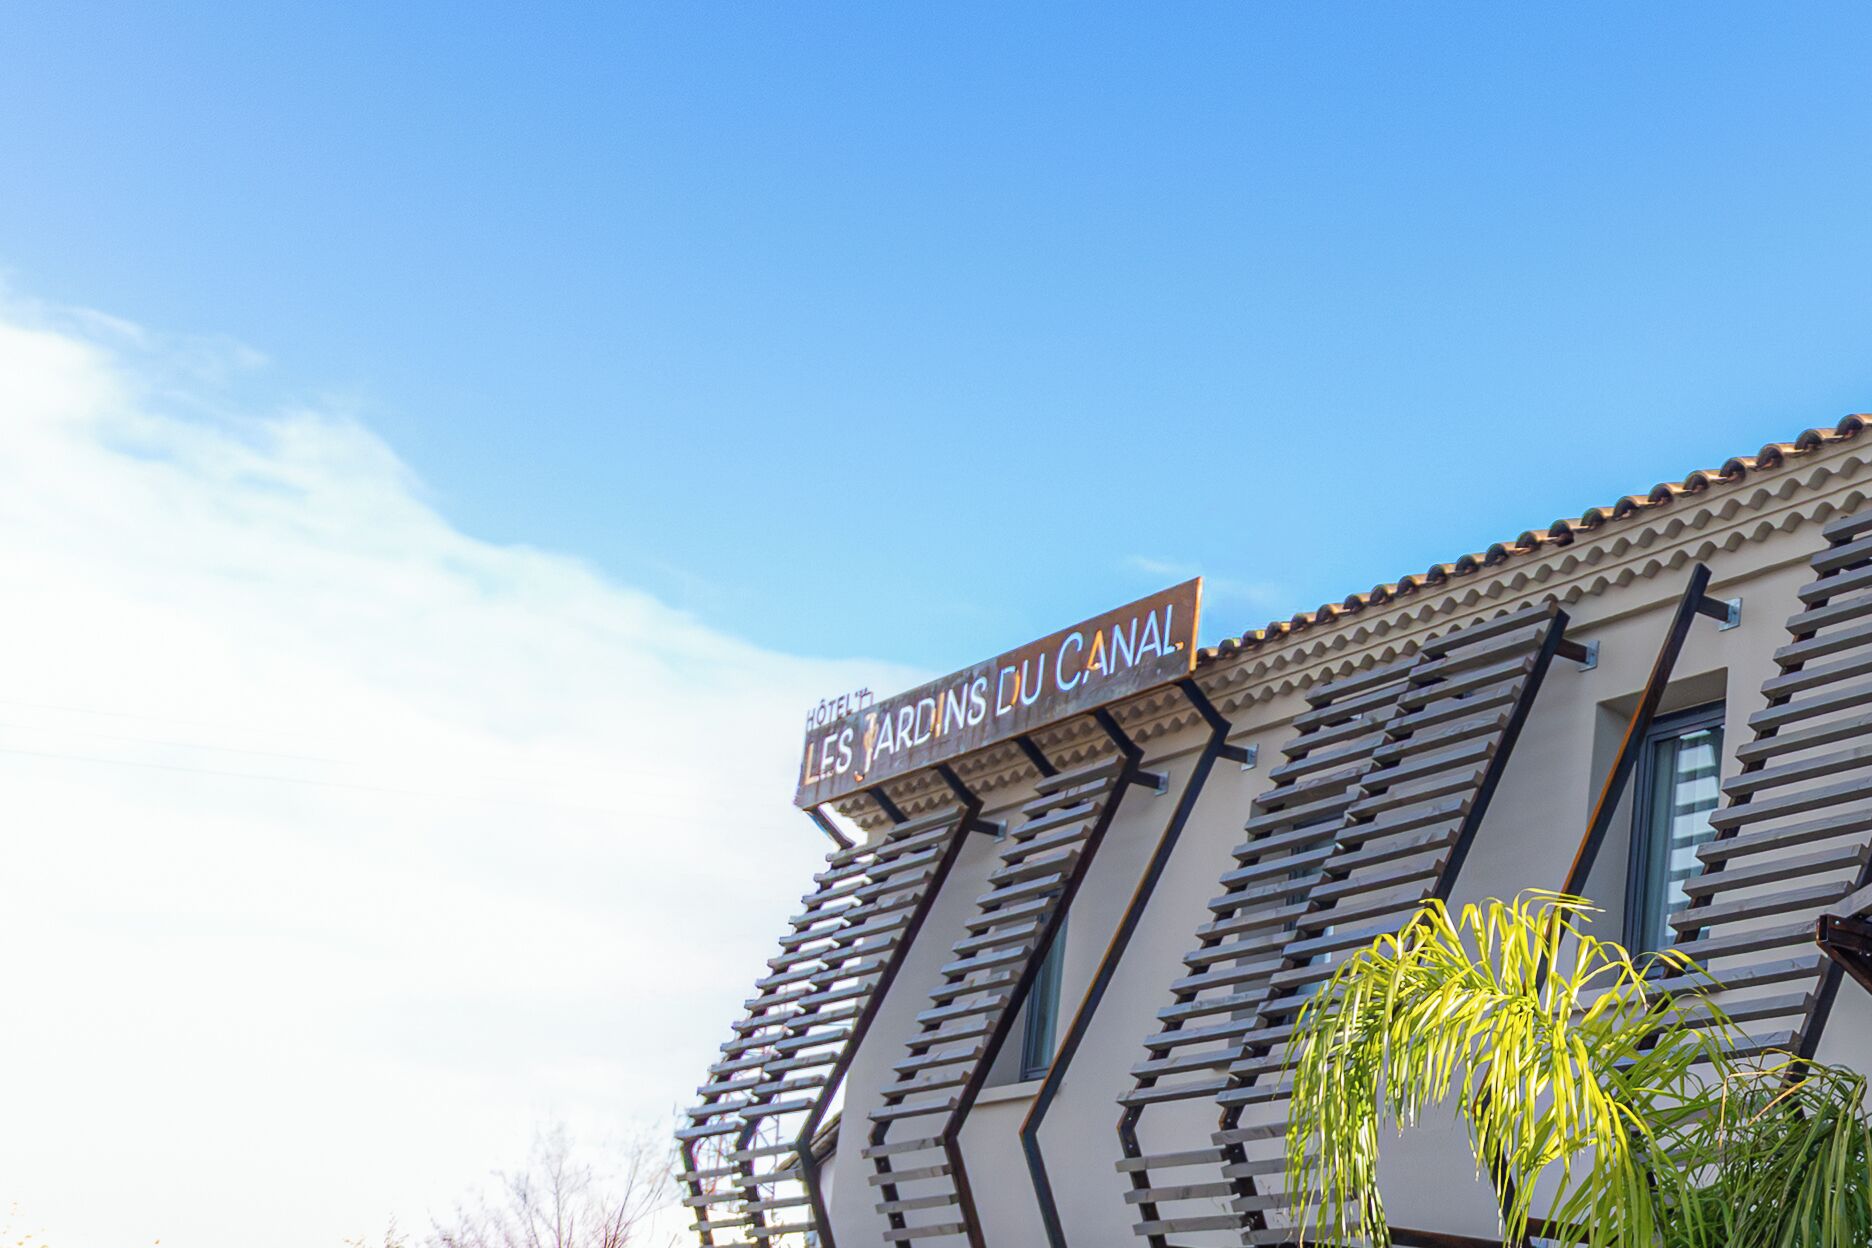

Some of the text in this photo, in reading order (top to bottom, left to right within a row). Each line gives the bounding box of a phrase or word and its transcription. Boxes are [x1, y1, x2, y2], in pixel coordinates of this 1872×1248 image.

[804, 603, 1184, 785] LES JARDINS DU CANAL
